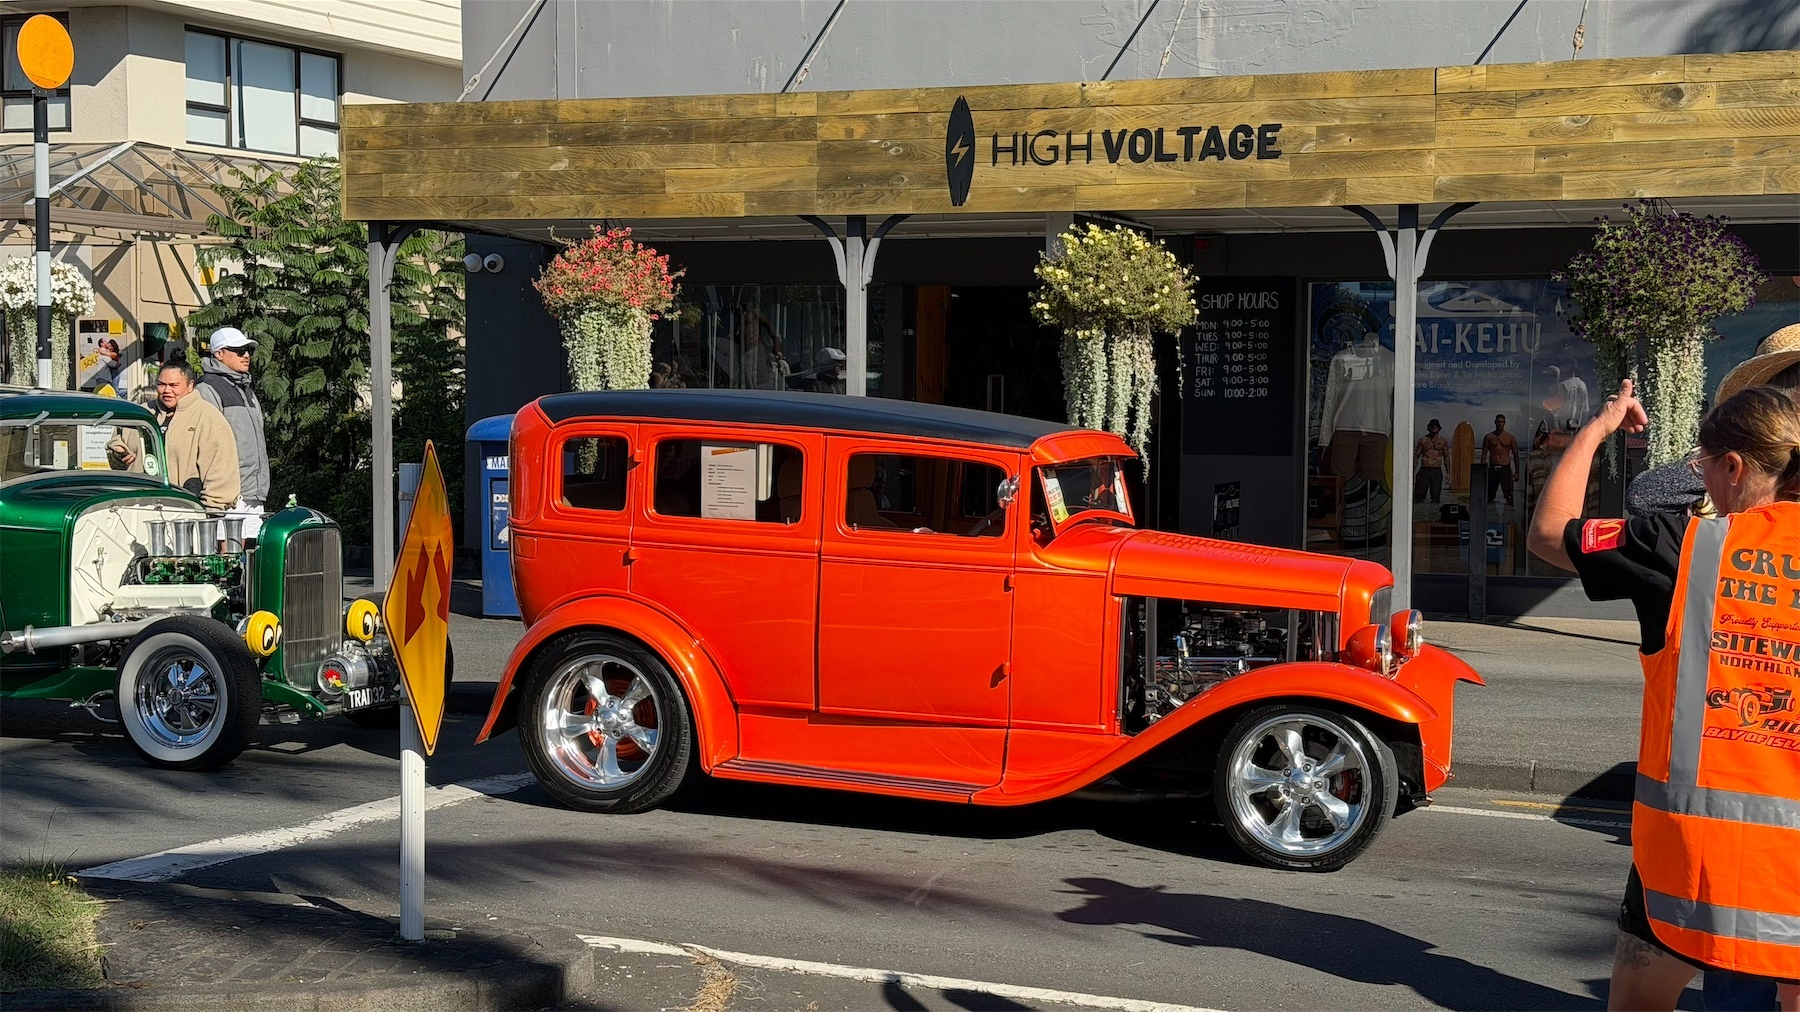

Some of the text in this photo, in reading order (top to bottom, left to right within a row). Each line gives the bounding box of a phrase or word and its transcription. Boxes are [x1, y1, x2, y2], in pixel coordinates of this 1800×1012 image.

[992, 123, 1283, 167] HIGH VOLTAGE
[1200, 291, 1279, 310] SHOP HOURS
[1195, 320, 1219, 331] MON:
[1389, 322, 1542, 354] AI-KEHU
[1194, 342, 1219, 353] WED:
[1195, 366, 1215, 377] FRI:
[1415, 360, 1521, 370] esigned and Developed by
[1194, 378, 1215, 388] SAT:
[1719, 577, 1778, 606] THE
[1719, 613, 1759, 630] Proudly
[348, 685, 386, 709] TRAD32
[1702, 726, 1746, 741] BAY
[1744, 731, 1767, 745] OF
